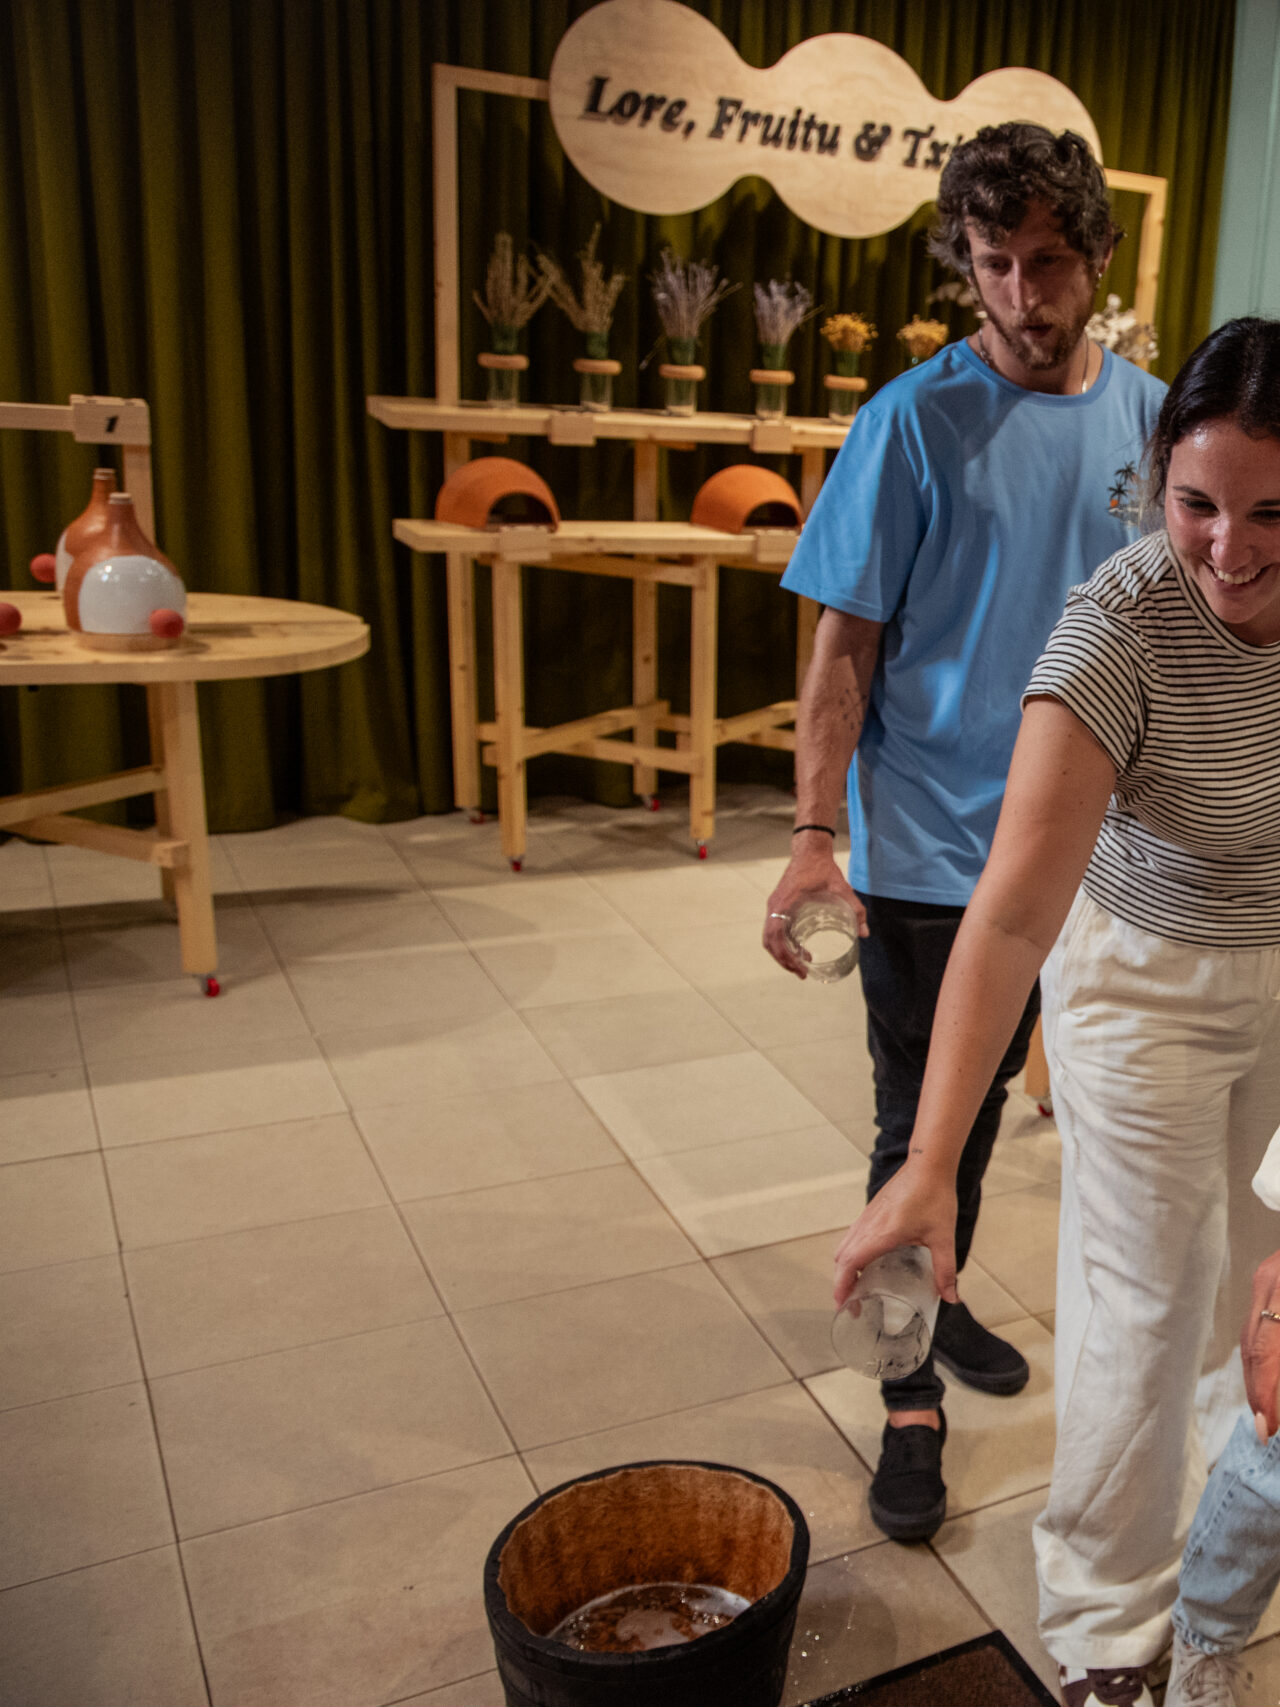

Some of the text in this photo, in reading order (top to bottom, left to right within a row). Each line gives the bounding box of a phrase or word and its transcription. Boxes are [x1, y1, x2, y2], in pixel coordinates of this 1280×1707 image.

[580, 75, 696, 140] Lore,
[708, 97, 841, 155] Fruitu
[854, 122, 892, 161] &
[105, 415, 119, 433] 1
